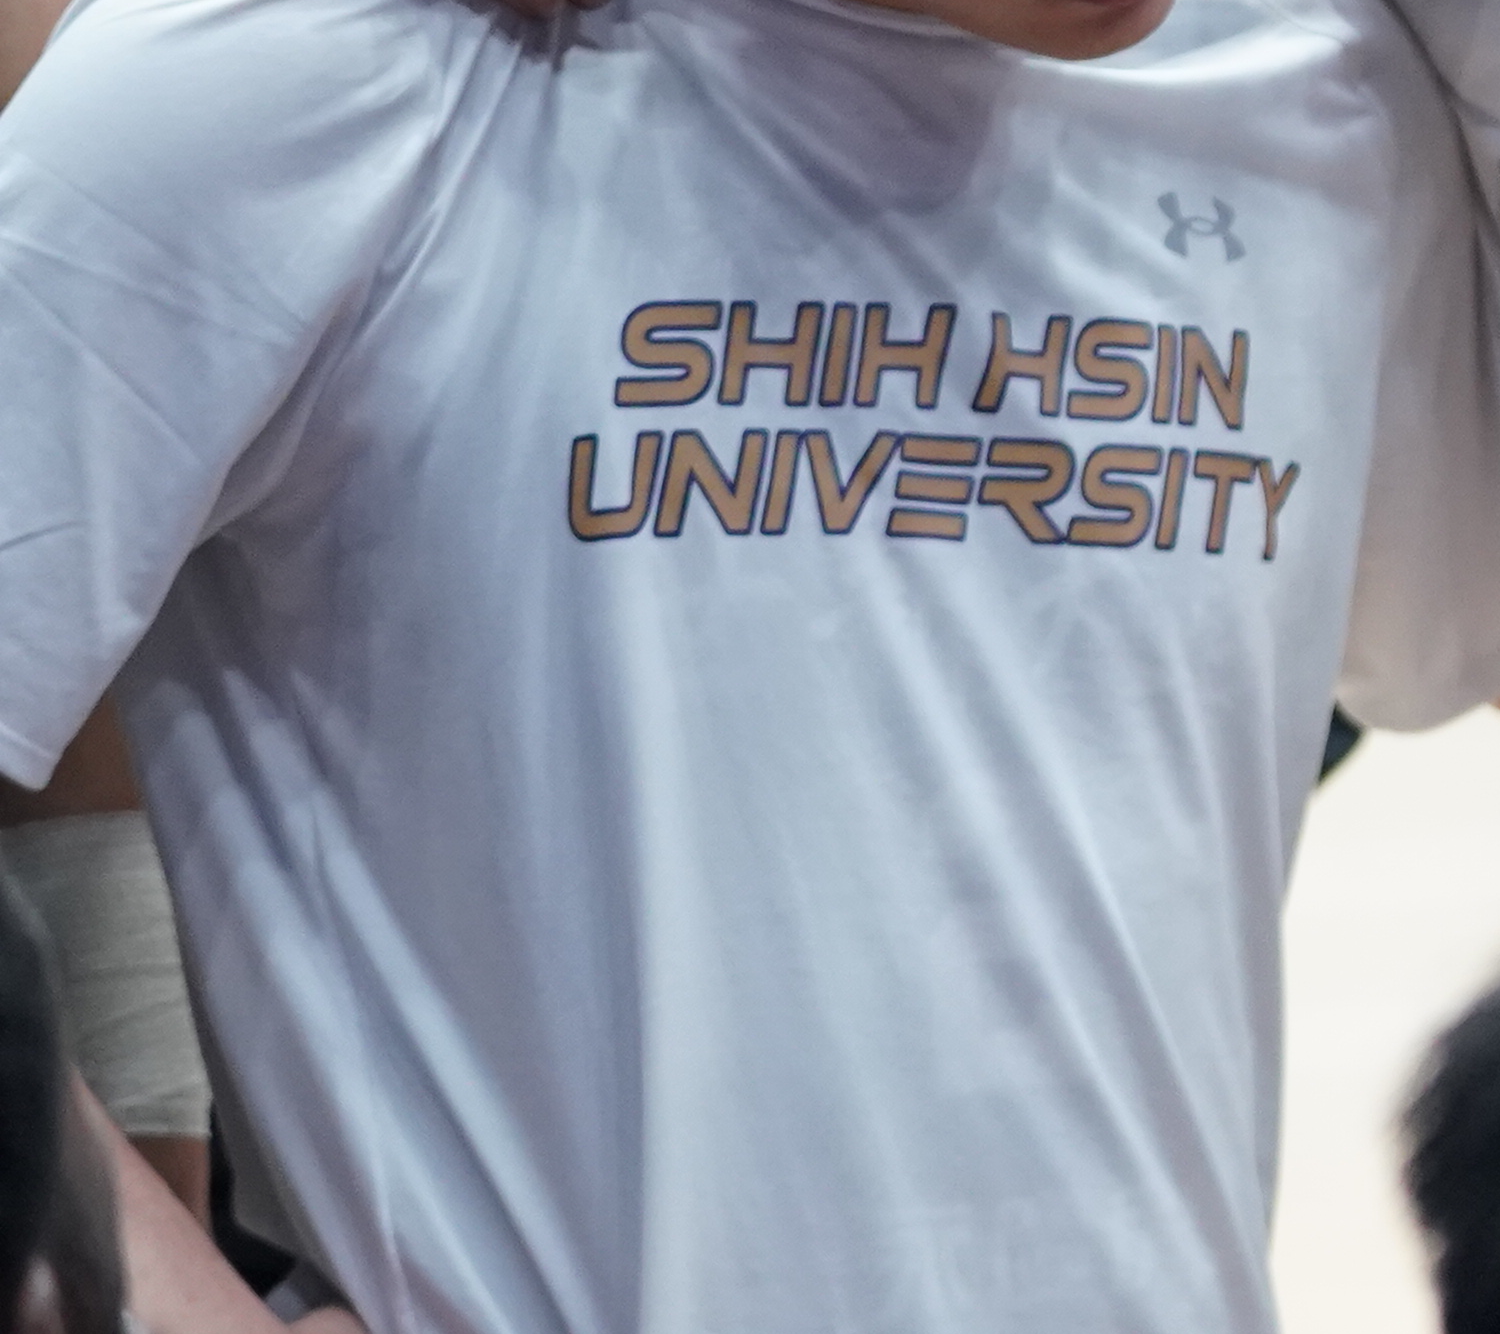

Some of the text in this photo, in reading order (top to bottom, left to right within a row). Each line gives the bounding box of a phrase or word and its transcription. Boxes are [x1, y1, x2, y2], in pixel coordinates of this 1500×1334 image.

[614, 300, 1250, 432] SHIH HSIN
[568, 428, 1301, 562] UNIVERSITY
